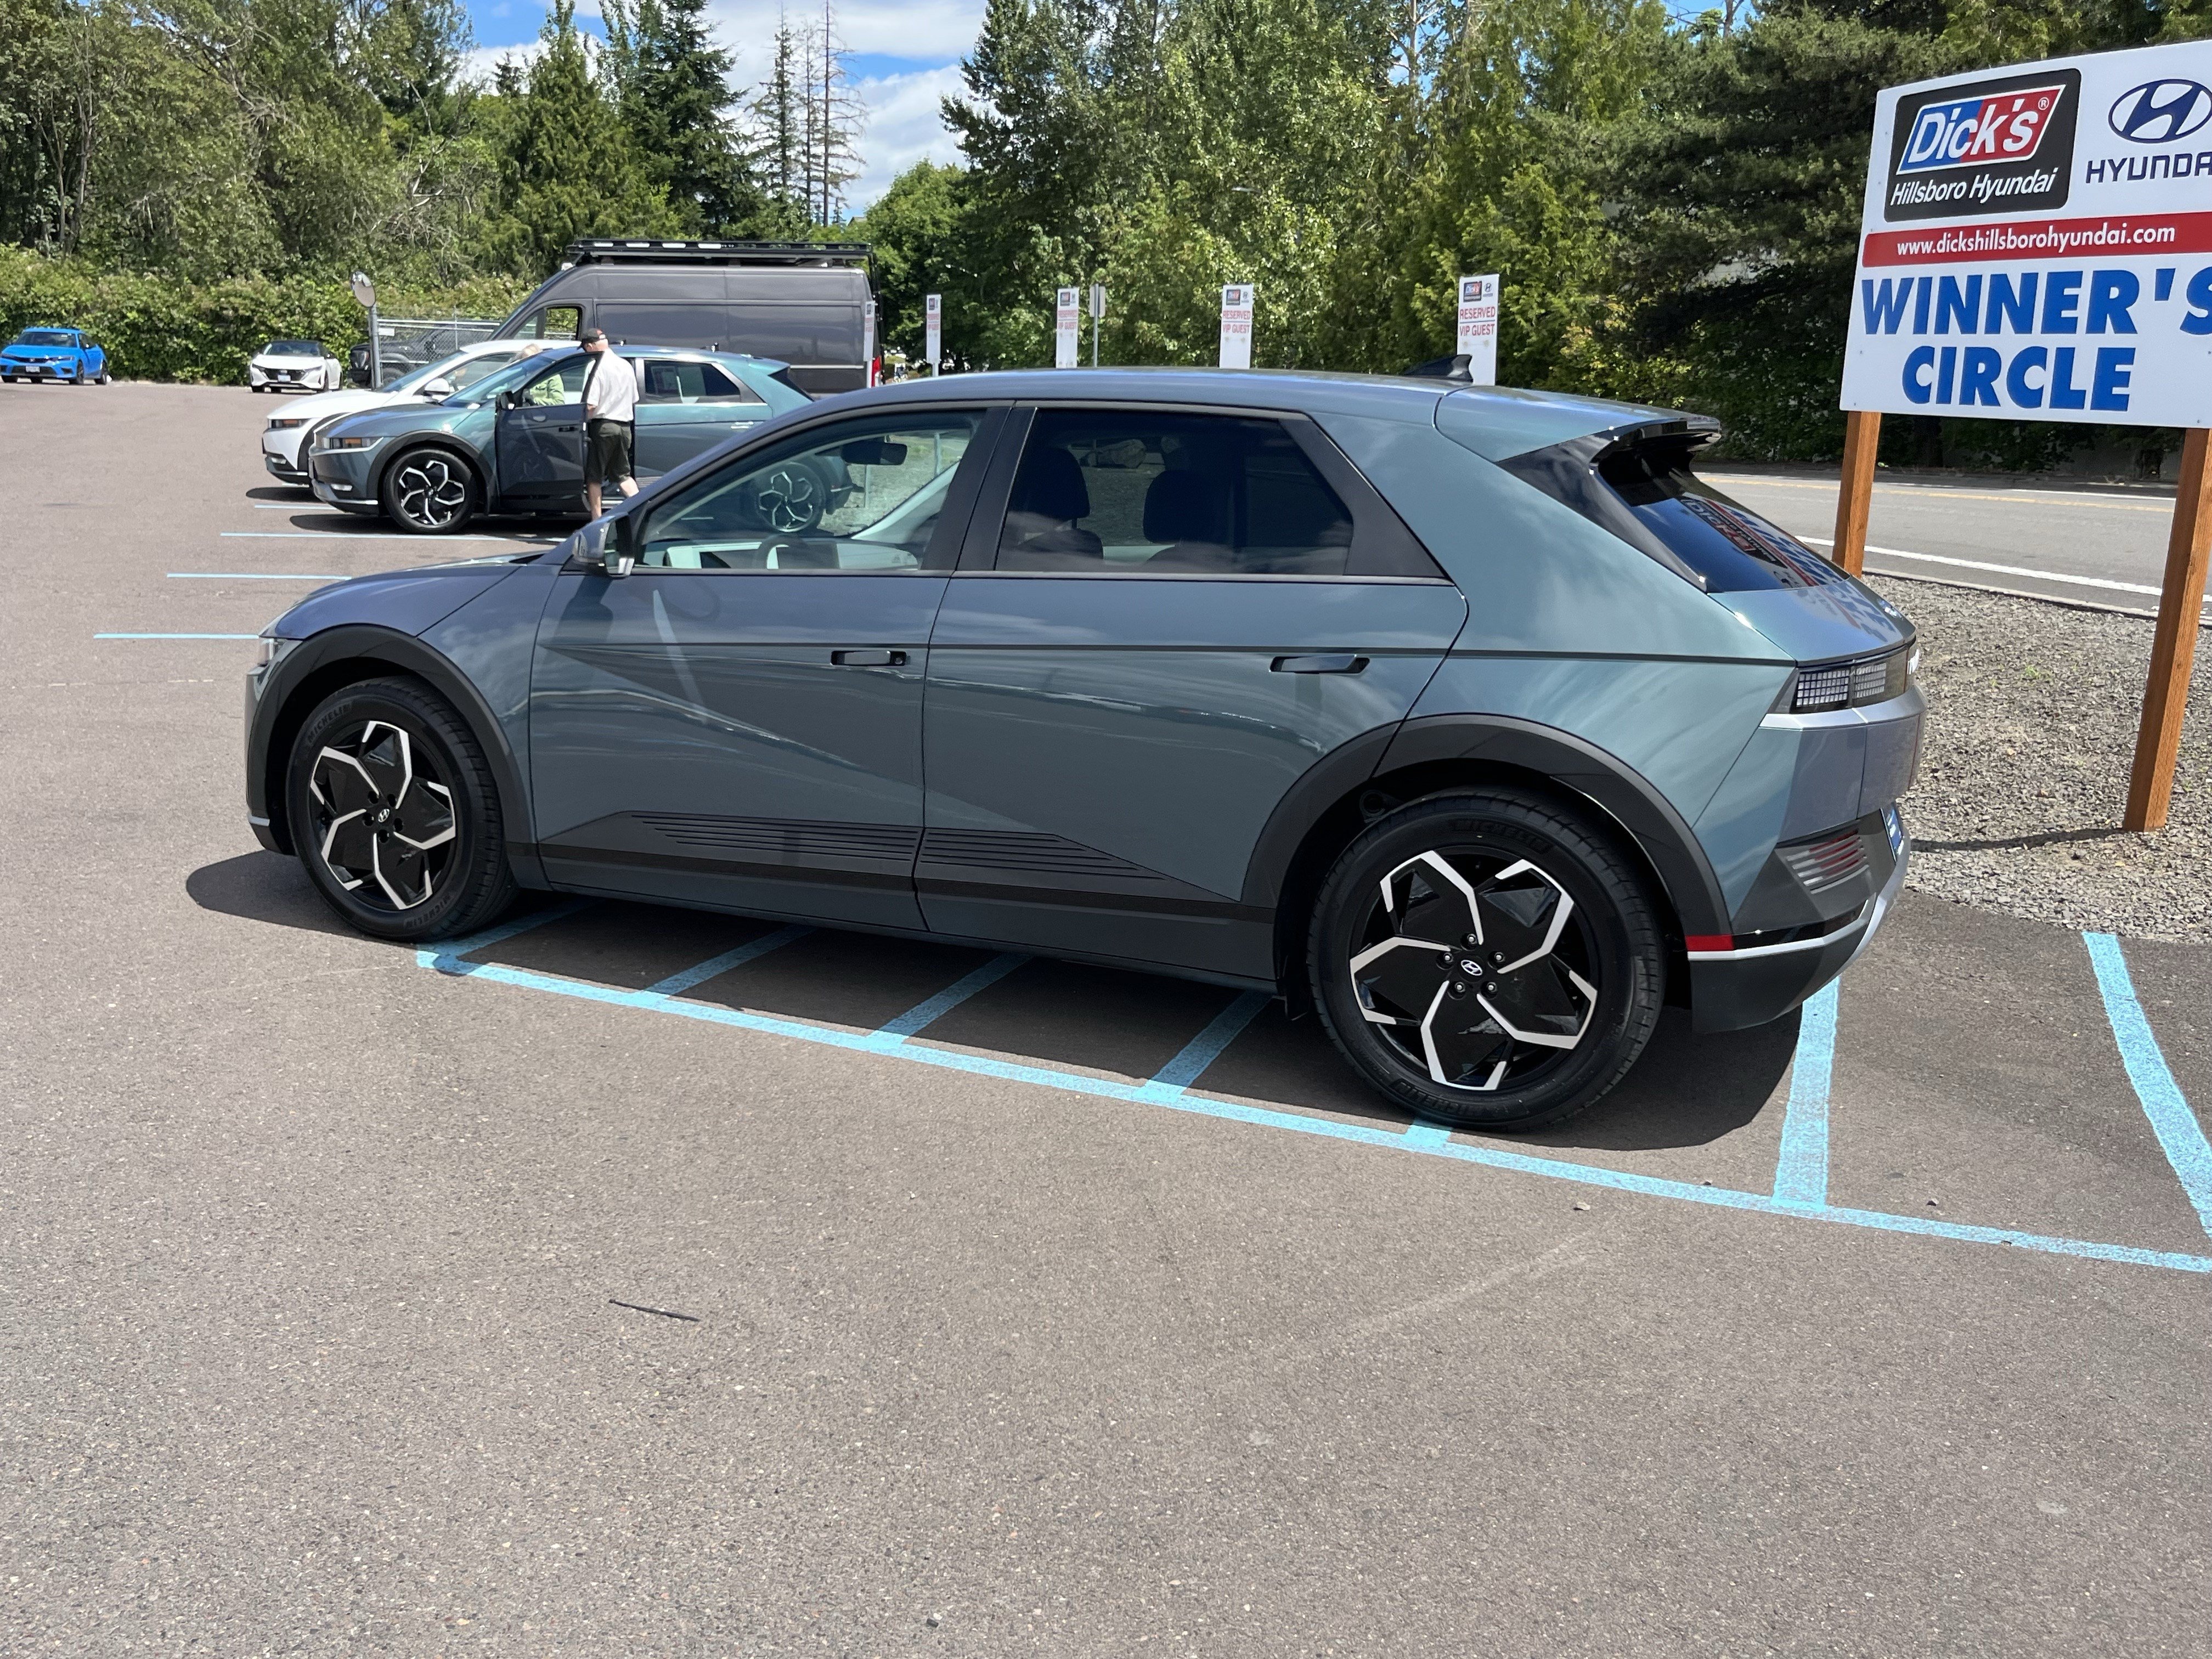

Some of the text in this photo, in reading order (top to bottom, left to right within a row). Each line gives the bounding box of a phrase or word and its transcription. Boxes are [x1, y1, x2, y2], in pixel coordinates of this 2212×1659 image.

[1890, 167, 2057, 206] Hillsboro Hyundai
[1897, 222, 2175, 256] www.dickshillsborohyundai.com
[1460, 306, 1496, 319] RESERVED
[1861, 266, 2212, 335] WINNER'S
[1460, 324, 1495, 336] VIP GUEST
[1902, 346, 2136, 411] CIRCLE
